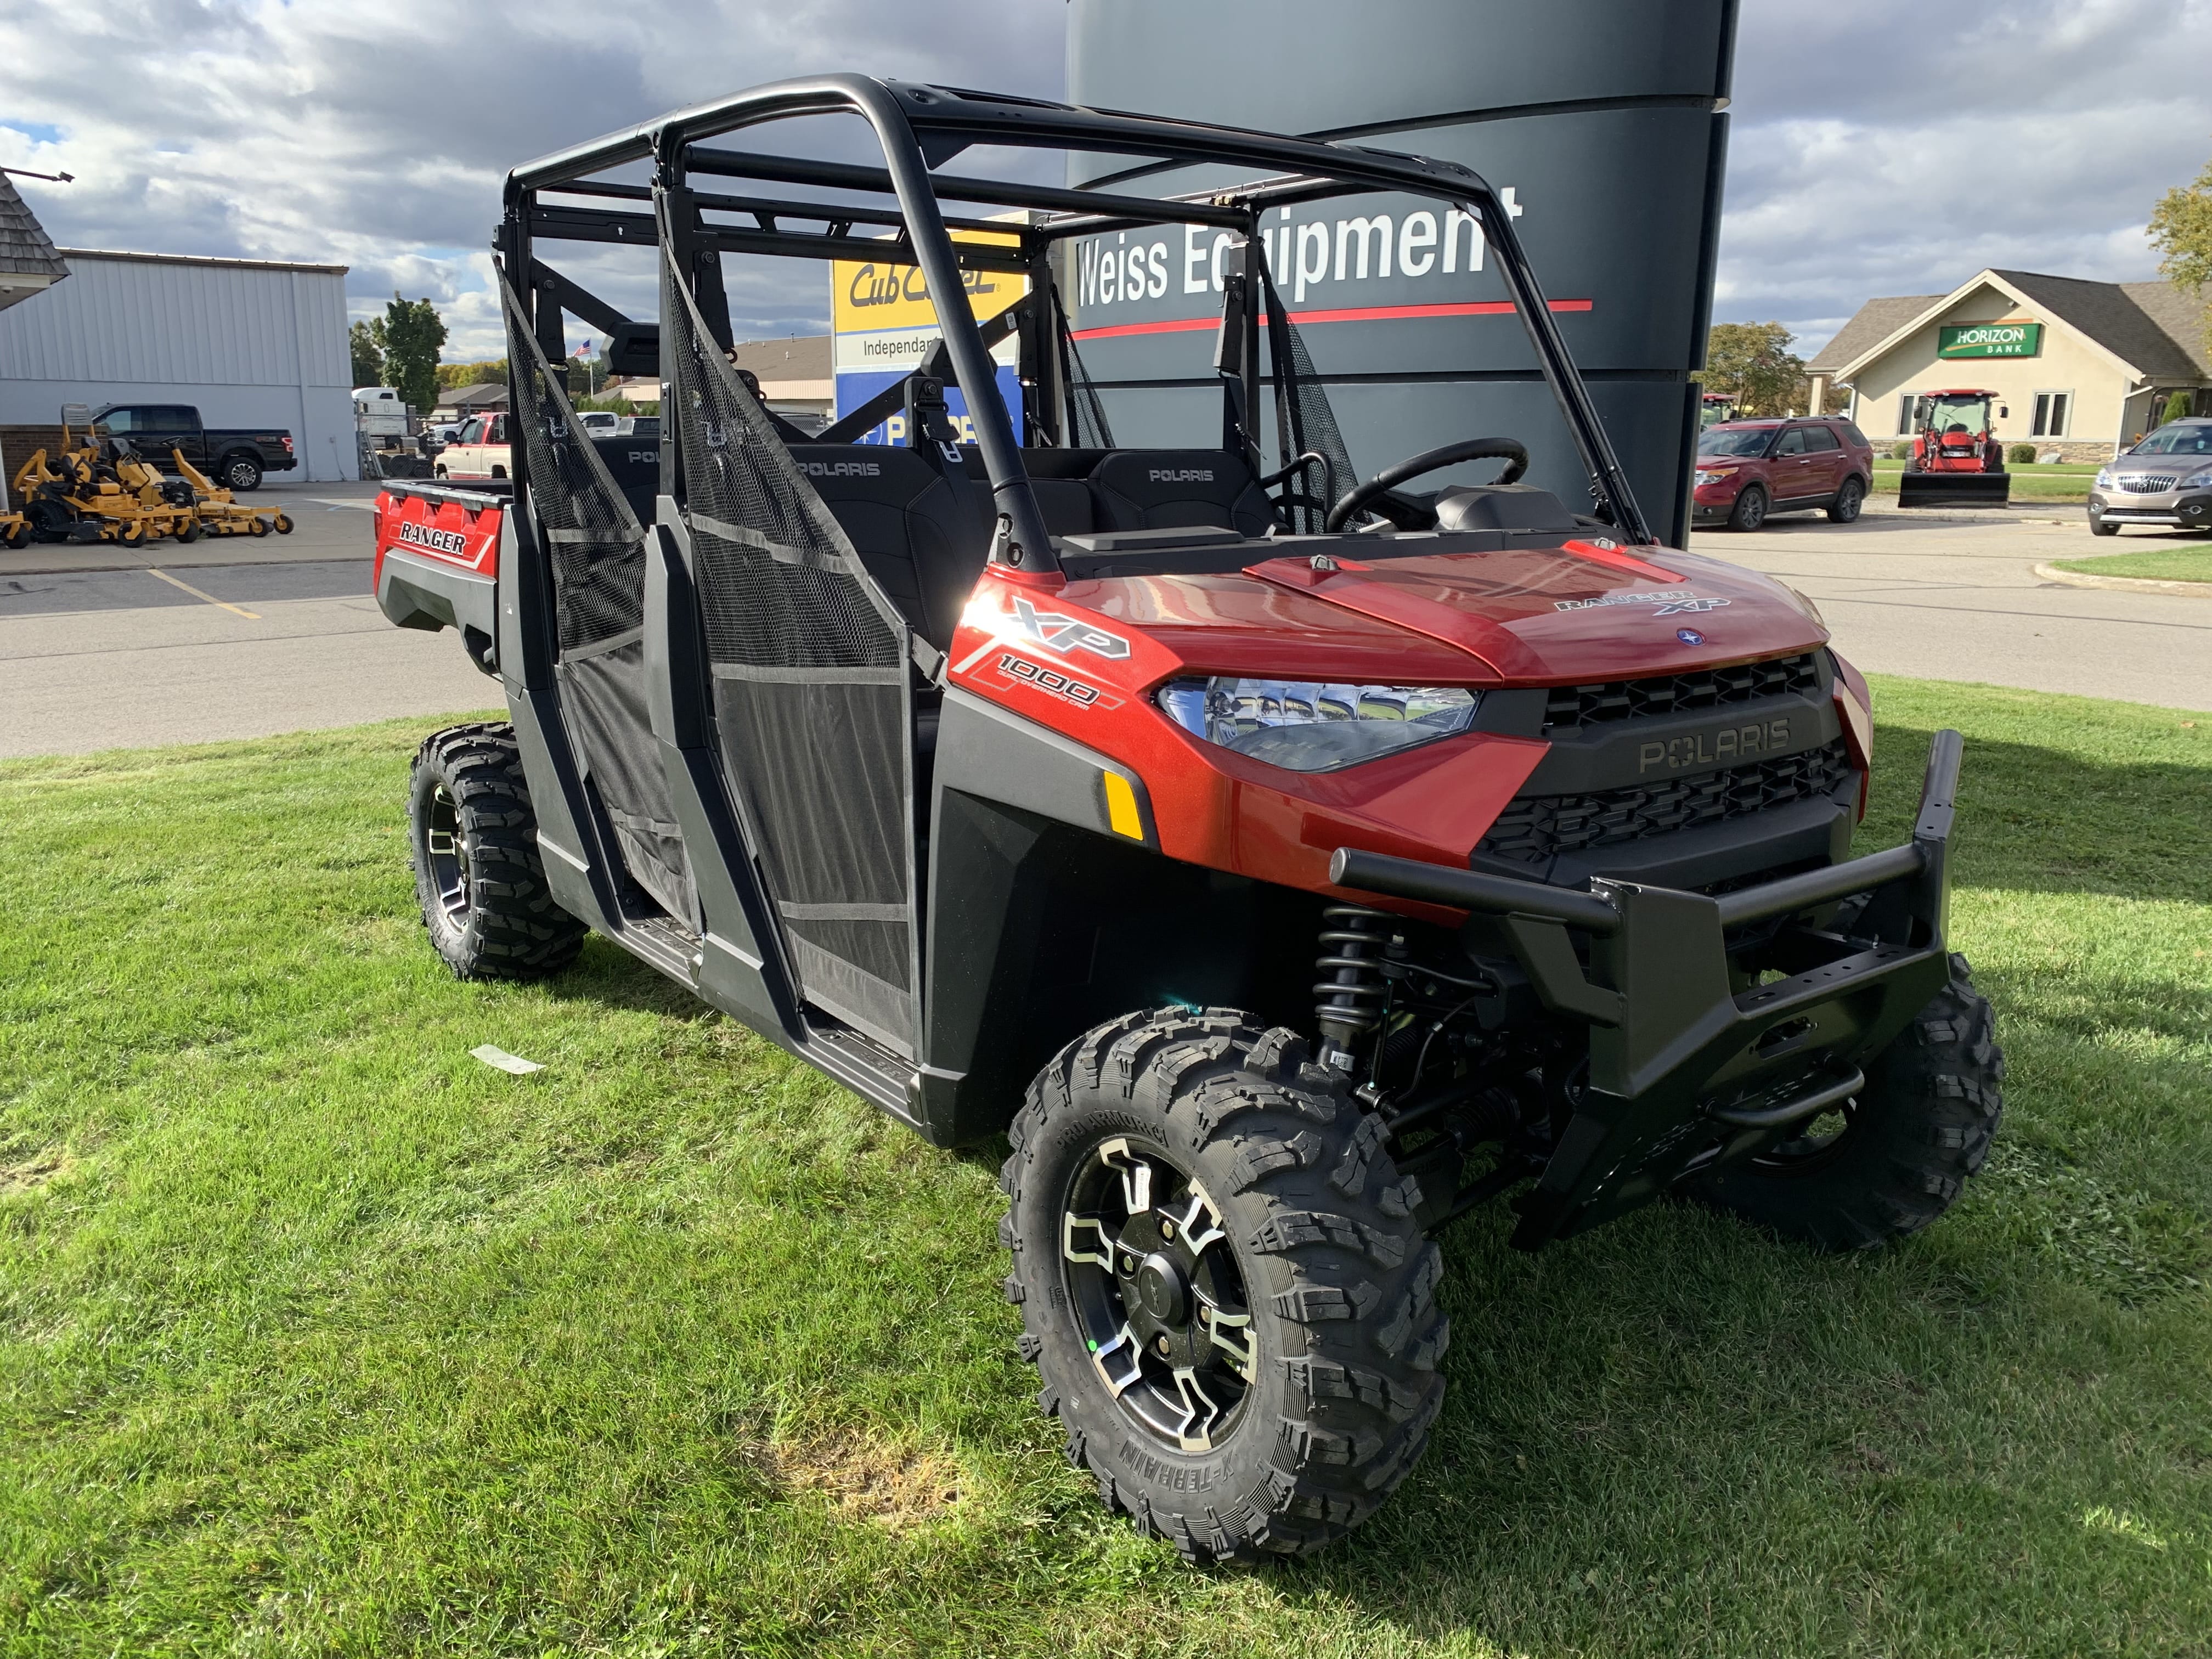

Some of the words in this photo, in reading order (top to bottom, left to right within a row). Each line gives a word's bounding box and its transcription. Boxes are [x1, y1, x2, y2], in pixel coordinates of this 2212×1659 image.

[850, 264, 900, 307] Cub
[1077, 233, 1168, 307] Weiss
[1957, 329, 2024, 343] HORIZON
[1987, 345, 2022, 353] BANK
[797, 462, 881, 476] POLARIS
[1149, 470, 1214, 482] POLARIS
[399, 521, 466, 556] RANGER
[1554, 591, 1697, 612] RANGER
[1652, 597, 1731, 616] XP
[1007, 594, 1132, 659] XP
[997, 653, 1101, 706] 1000
[997, 670, 1019, 682] DUAL
[1068, 699, 1090, 711] CAM
[1639, 718, 1790, 773] POLARIS
[1118, 1436, 1234, 1494] X-TERRAIN
